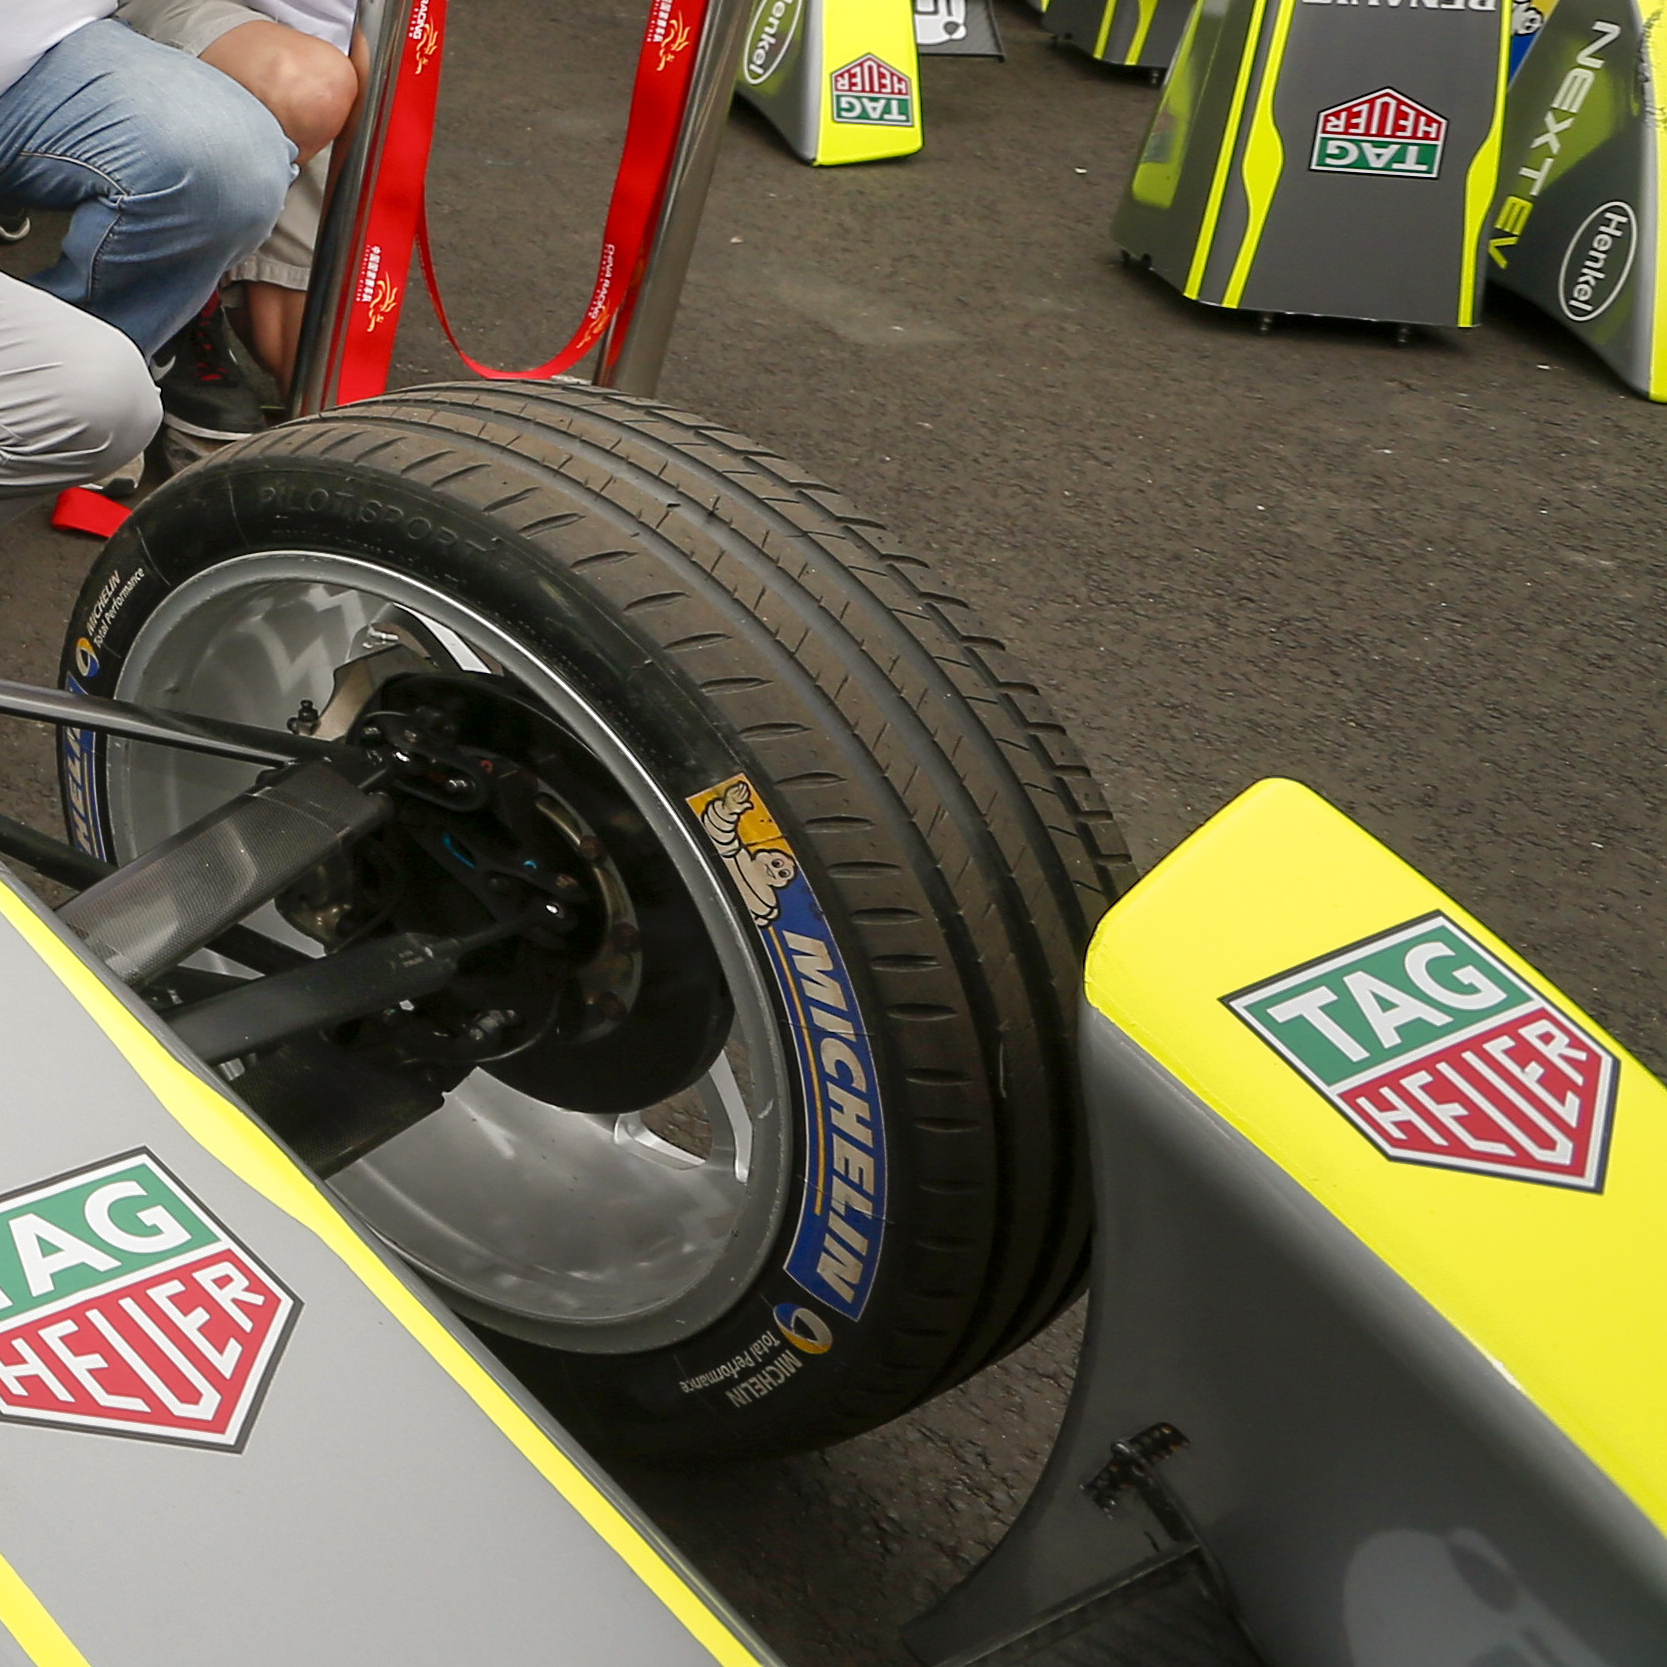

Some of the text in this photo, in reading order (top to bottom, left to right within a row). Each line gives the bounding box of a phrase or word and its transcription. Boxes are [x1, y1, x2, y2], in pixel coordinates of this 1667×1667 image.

[836, 60, 907, 94] HEUER
[839, 95, 908, 122] TAG
[1324, 94, 1440, 138] HEUER
[1486, 19, 1621, 270] NEXTEV
[1323, 139, 1434, 173] TAG
[1567, 211, 1629, 314] Henkel
[85, 570, 121, 636] MICHELIN
[93, 566, 146, 649] Total Performance
[1266, 941, 1508, 1063] TAG
[785, 931, 877, 1308] MICHELIN
[1356, 1017, 1589, 1166] HEUER
[678, 1330, 782, 1394] Total Performance
[724, 1349, 803, 1408] MICHELIN
